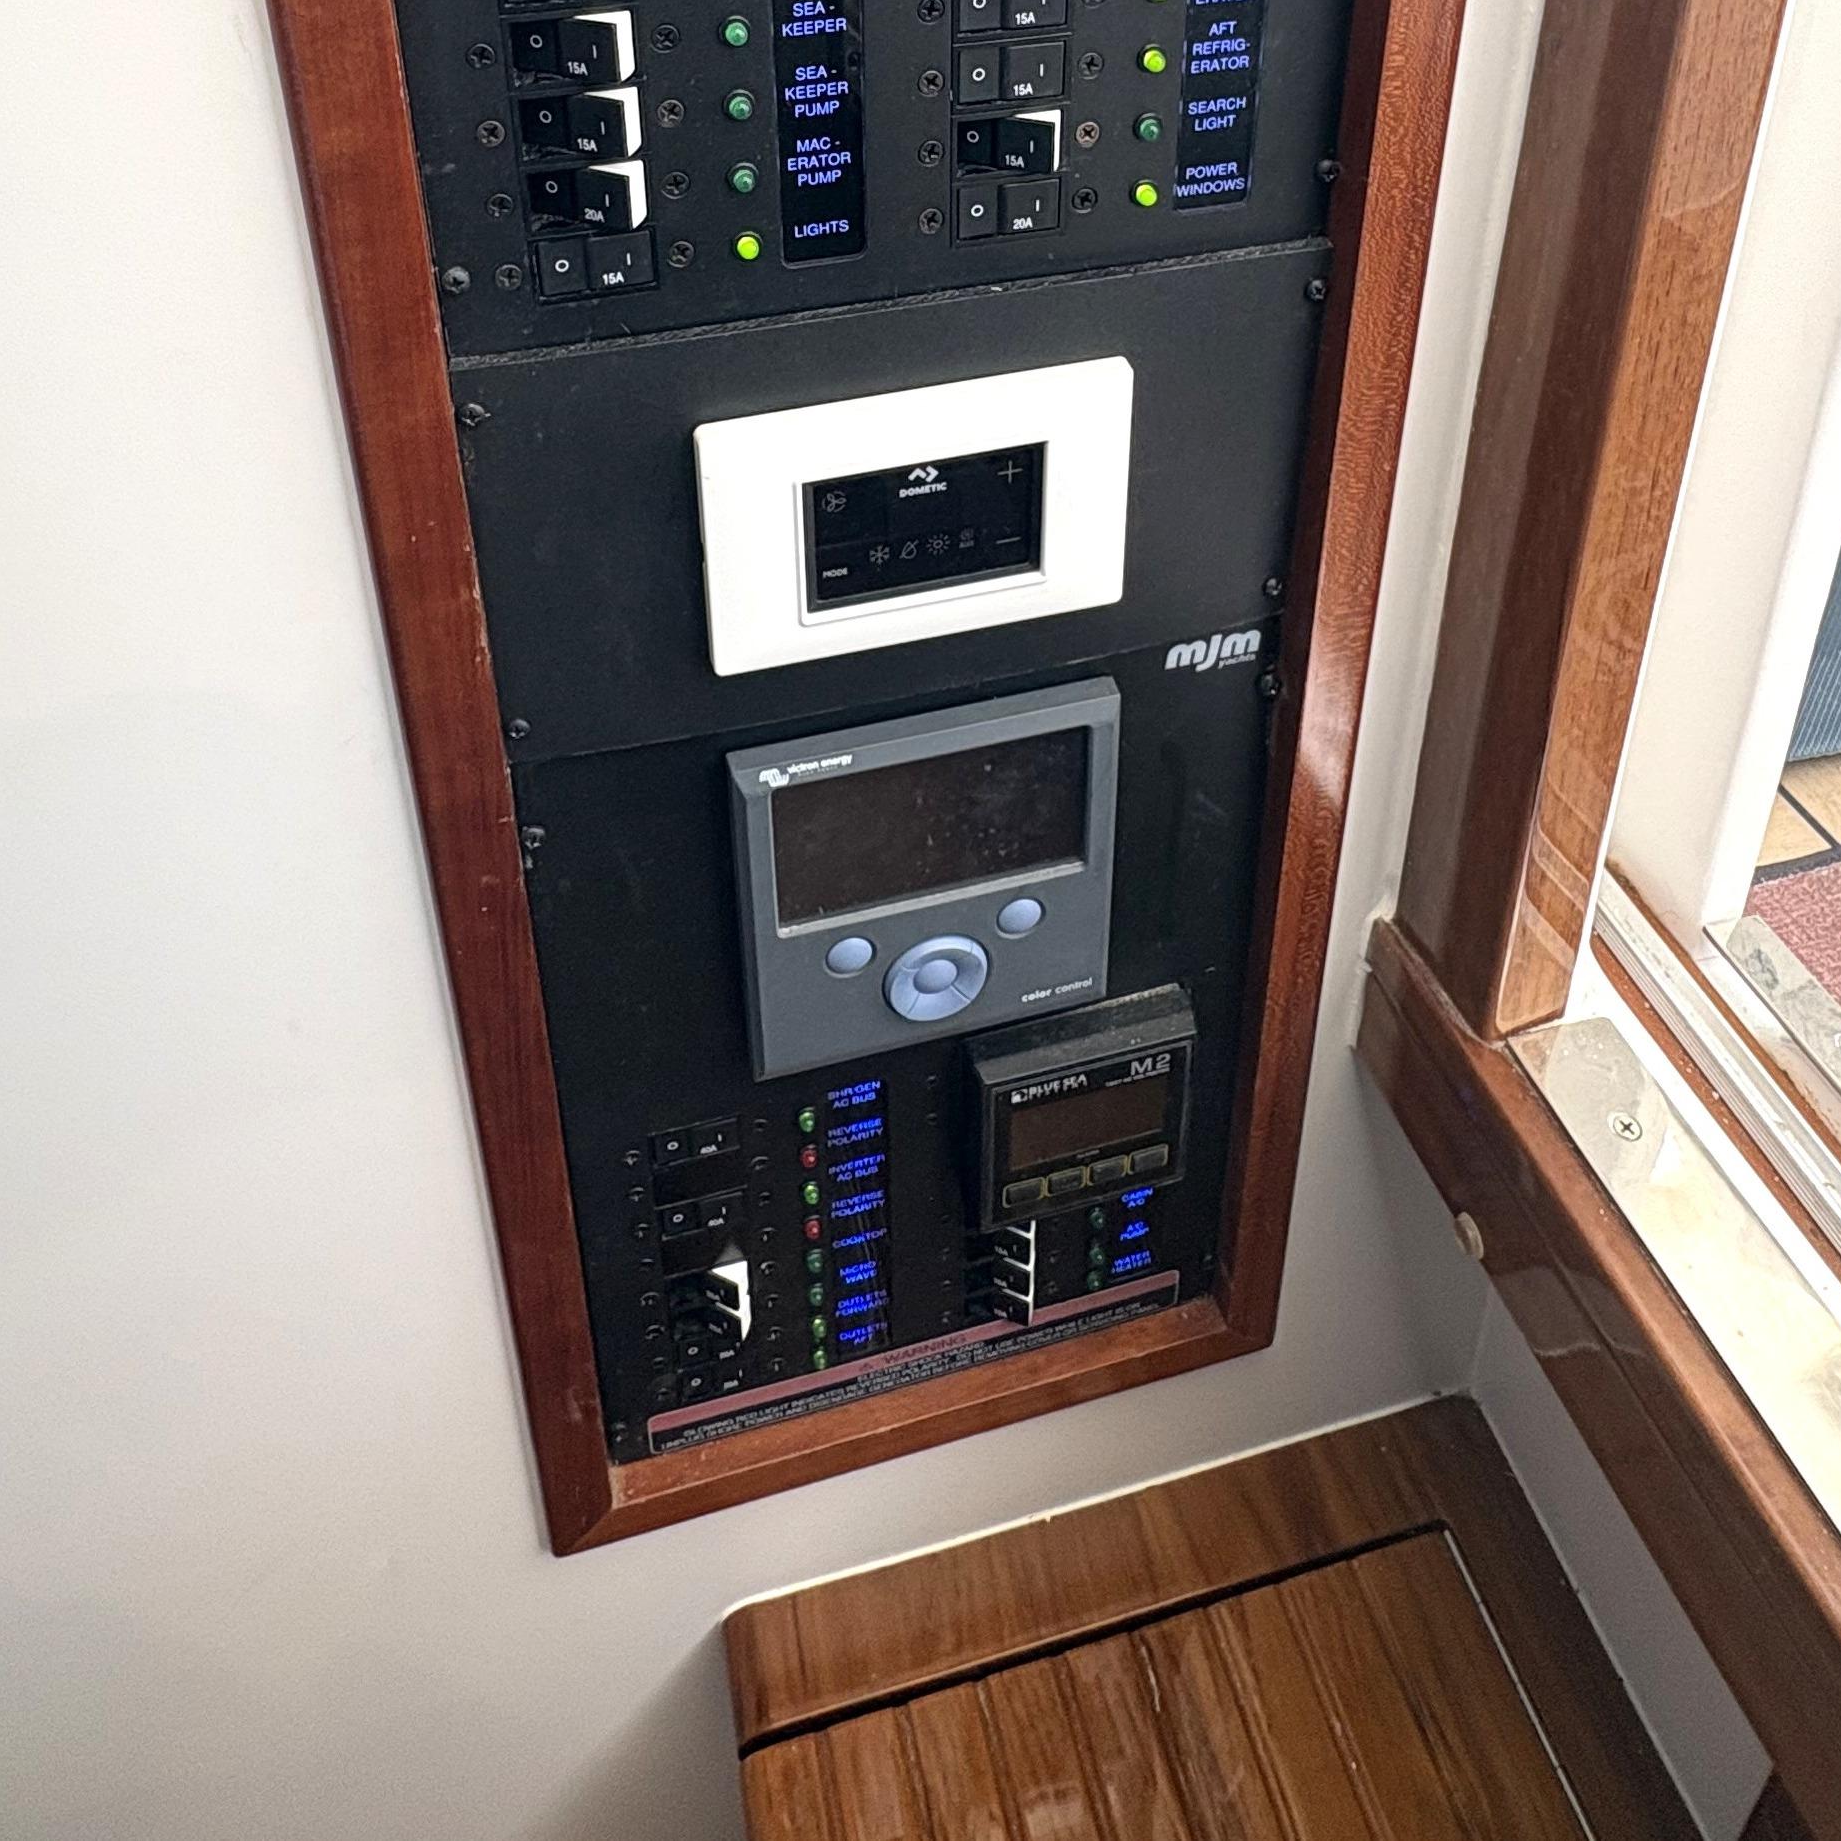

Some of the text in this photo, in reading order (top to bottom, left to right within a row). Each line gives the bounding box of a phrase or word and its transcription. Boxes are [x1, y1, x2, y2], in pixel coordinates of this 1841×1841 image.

[792, 2, 825, 18] SEA
[1015, 11, 1035, 24] 15A
[781, 17, 847, 38] KEEPER
[1208, 21, 1237, 36] AFT
[567, 62, 587, 77] 15A
[1190, 56, 1250, 74] ERATOR
[795, 67, 827, 81] SEA
[784, 81, 849, 100] KEEPER
[1013, 83, 1033, 96] 15A
[794, 100, 840, 118] PUMP
[1187, 96, 1246, 114] SEARCH
[1194, 115, 1237, 132] LIGHT
[577, 138, 597, 153] 15A
[796, 138, 831, 153] MAC
[787, 152, 852, 172] ERATOR
[1004, 155, 1024, 168] 15A
[797, 170, 842, 187] PUMP
[1185, 162, 1237, 179] POWER
[1176, 178, 1245, 198] WINDOWS
[584, 208, 604, 223] 20A
[1013, 217, 1033, 230] 20A
[794, 219, 849, 238] LIGHTS
[602, 272, 625, 286] 15A
[899, 481, 947, 499] DOMETIC
[823, 567, 848, 578] MODE
[1164, 629, 1261, 672] mjm
[821, 754, 852, 767] energy
[1021, 977, 1093, 1003] color control
[827, 1128, 884, 1148] POLARITY
